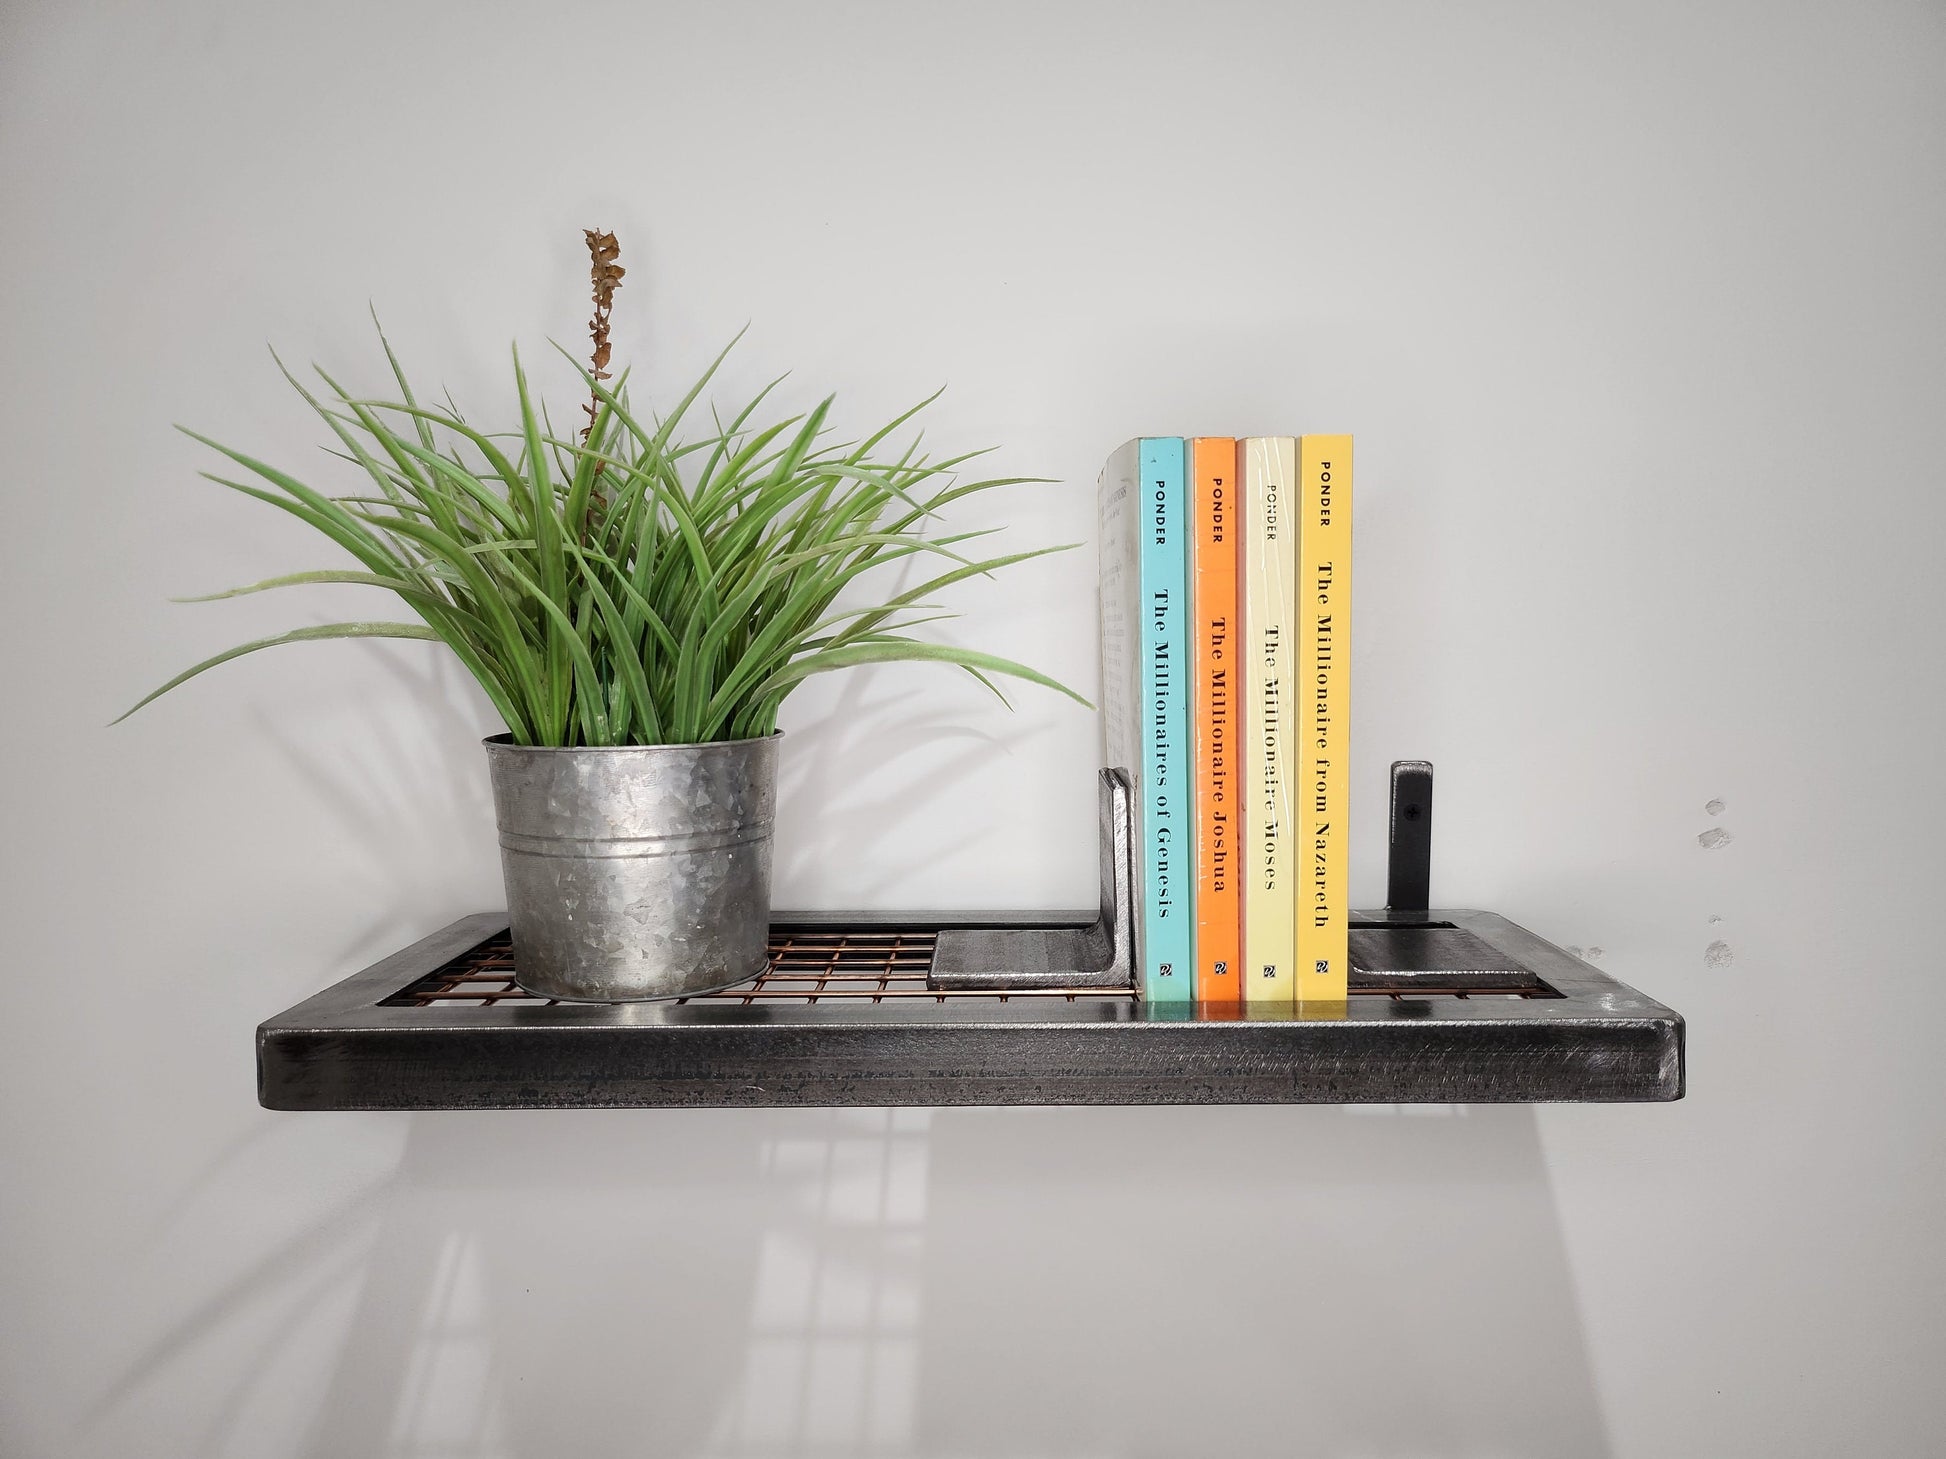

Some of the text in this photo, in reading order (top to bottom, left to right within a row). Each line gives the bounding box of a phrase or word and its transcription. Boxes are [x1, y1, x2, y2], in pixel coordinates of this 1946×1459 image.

[1155, 480, 1166, 545] PONDER
[1212, 478, 1223, 544] PONDER
[1266, 485, 1277, 541] PONDER
[1320, 461, 1331, 527] PONDER
[1154, 588, 1173, 918] The Millionaires of Genesis
[1211, 616, 1228, 893] The Millionaire Joshua
[1264, 624, 1279, 890] The Millionaire Moses
[1314, 561, 1333, 927] The Millionaire from Nazareth
